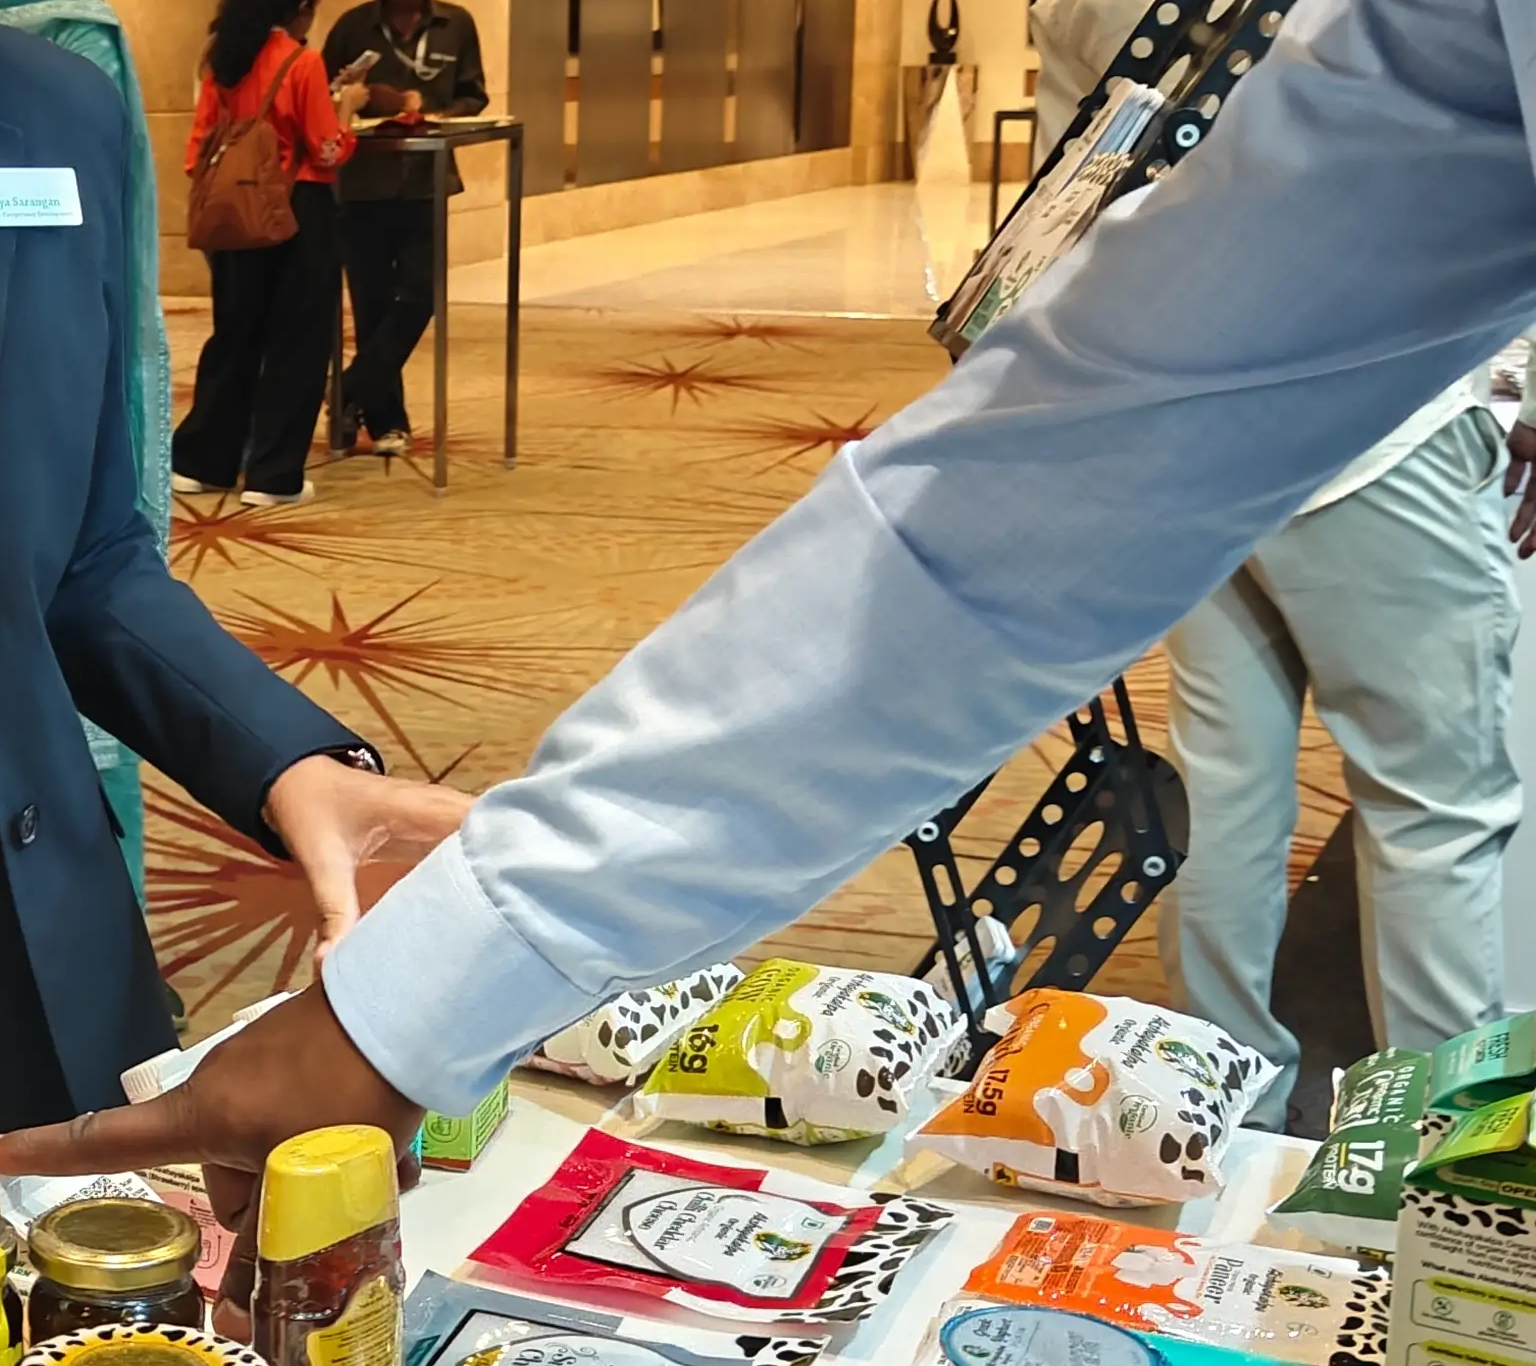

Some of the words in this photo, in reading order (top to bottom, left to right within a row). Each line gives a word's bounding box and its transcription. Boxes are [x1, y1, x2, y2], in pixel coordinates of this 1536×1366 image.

[13, 198, 60, 209] Sarangan
[680, 1024, 720, 1074] 16g
[977, 1068, 1010, 1116] 17.5g
[1383, 1065, 1416, 1123] ORGANIC
[1321, 1142, 1338, 1190] PROTEIN
[1338, 1140, 1385, 1195] 17g
[653, 1210, 697, 1251] Cheddar
[1203, 1255, 1244, 1306] Paneer
